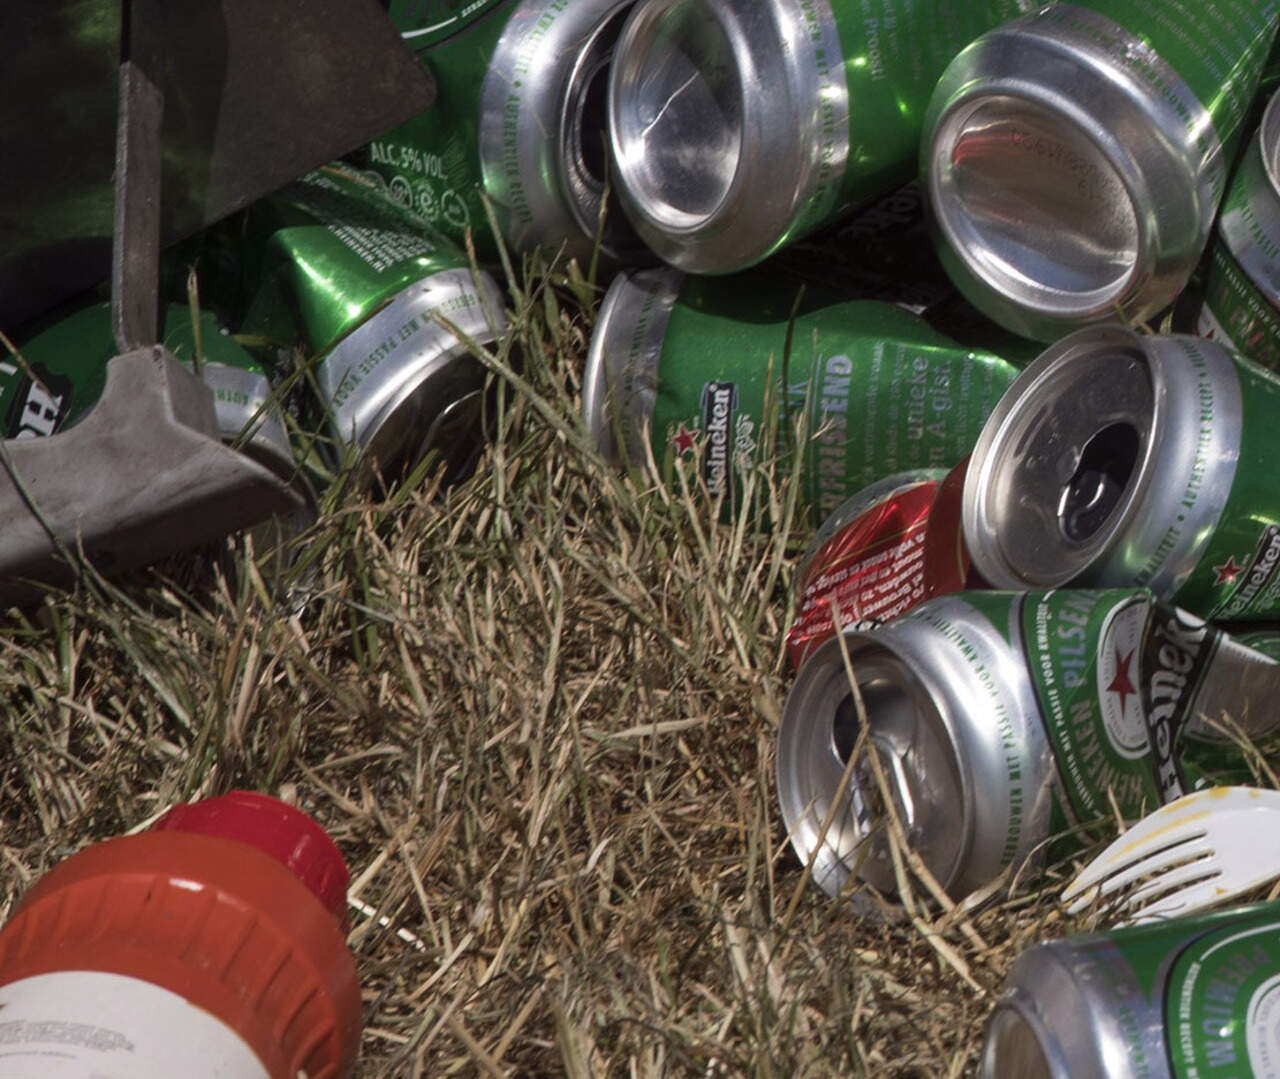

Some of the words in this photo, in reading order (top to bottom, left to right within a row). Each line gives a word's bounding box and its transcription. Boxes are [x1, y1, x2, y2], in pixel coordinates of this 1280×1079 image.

[706, 386, 733, 496] Heineken
[904, 355, 929, 441] unieke
[1005, 755, 1022, 782] MET
[1203, 943, 1273, 1068] PREMIUM
